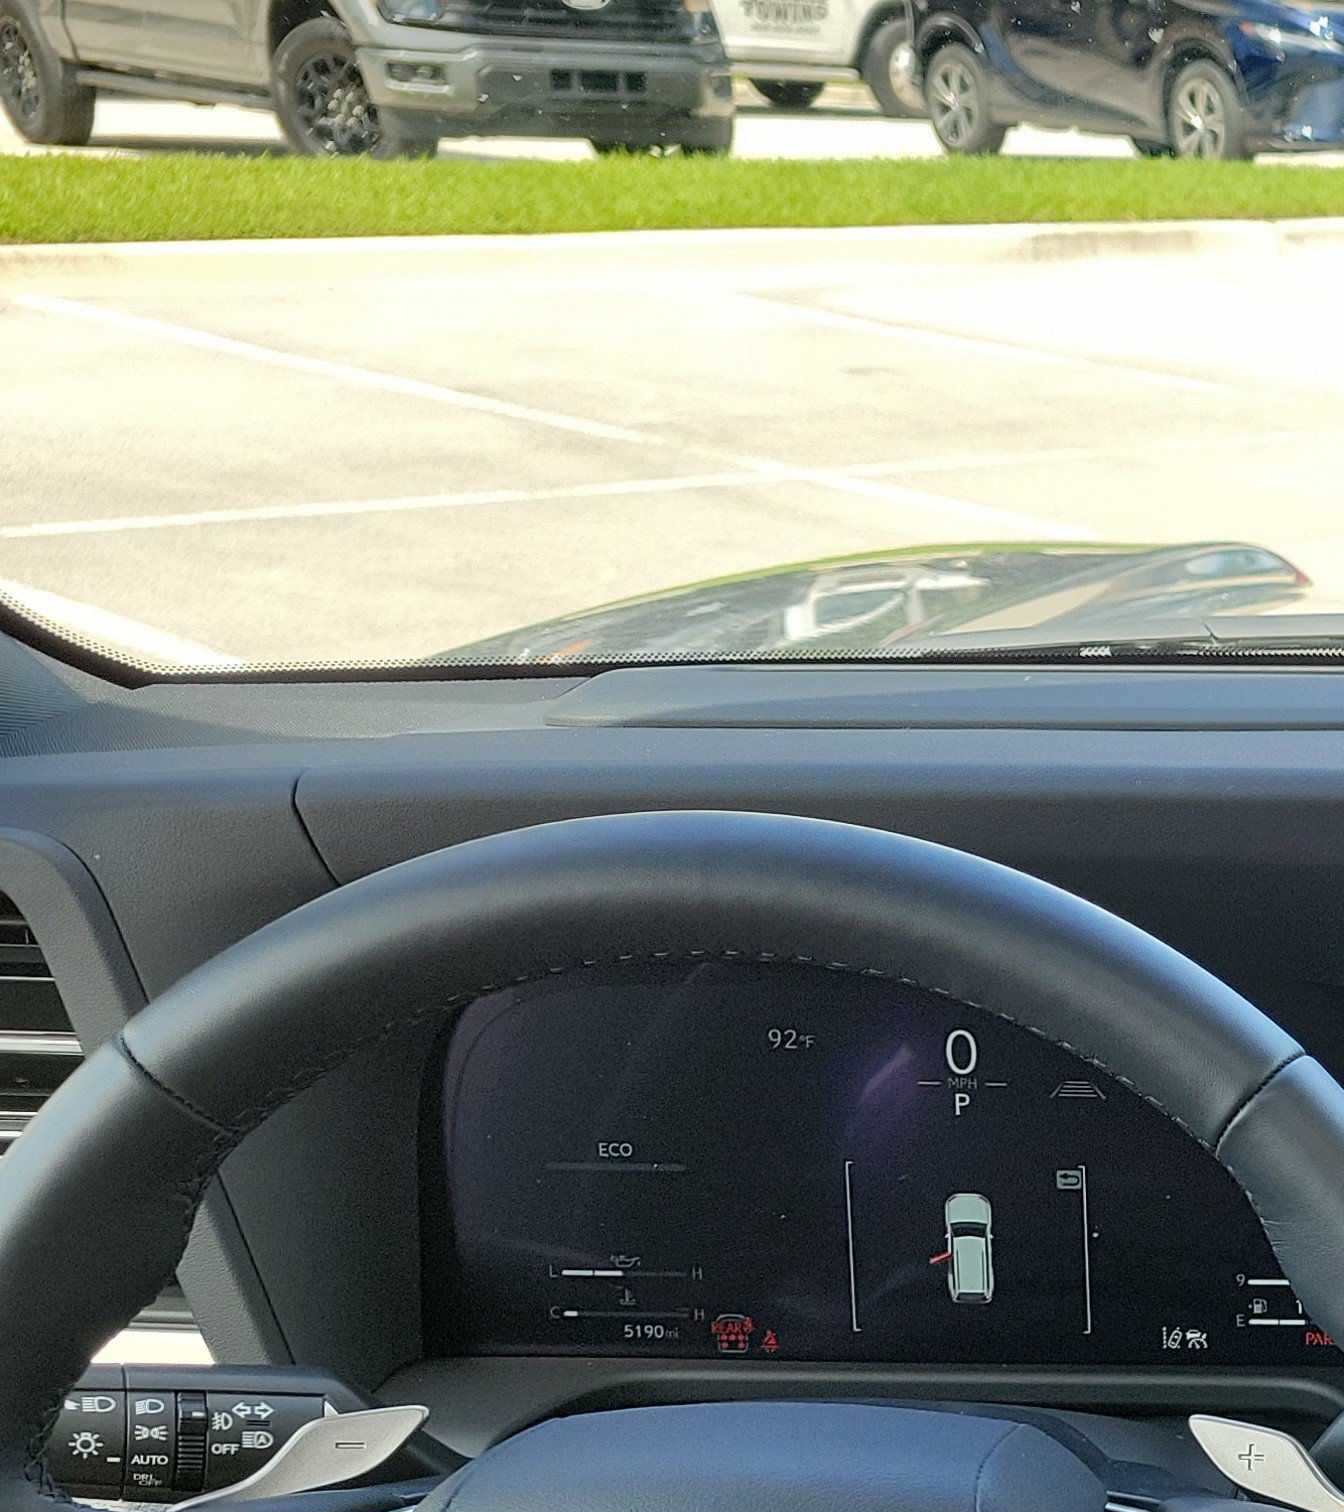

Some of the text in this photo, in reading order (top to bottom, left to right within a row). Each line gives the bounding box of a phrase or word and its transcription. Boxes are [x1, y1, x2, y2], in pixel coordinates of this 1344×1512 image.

[945, 1029, 978, 1076] 0
[947, 1077, 979, 1090] MPH
[954, 1093, 971, 1116] P
[598, 1142, 633, 1158] ECO
[1236, 1273, 1246, 1287] 9
[1236, 1314, 1246, 1327] E
[1304, 1332, 1336, 1346] PAR
[211, 1443, 240, 1455] OFF
[131, 1454, 169, 1466] AUTO
